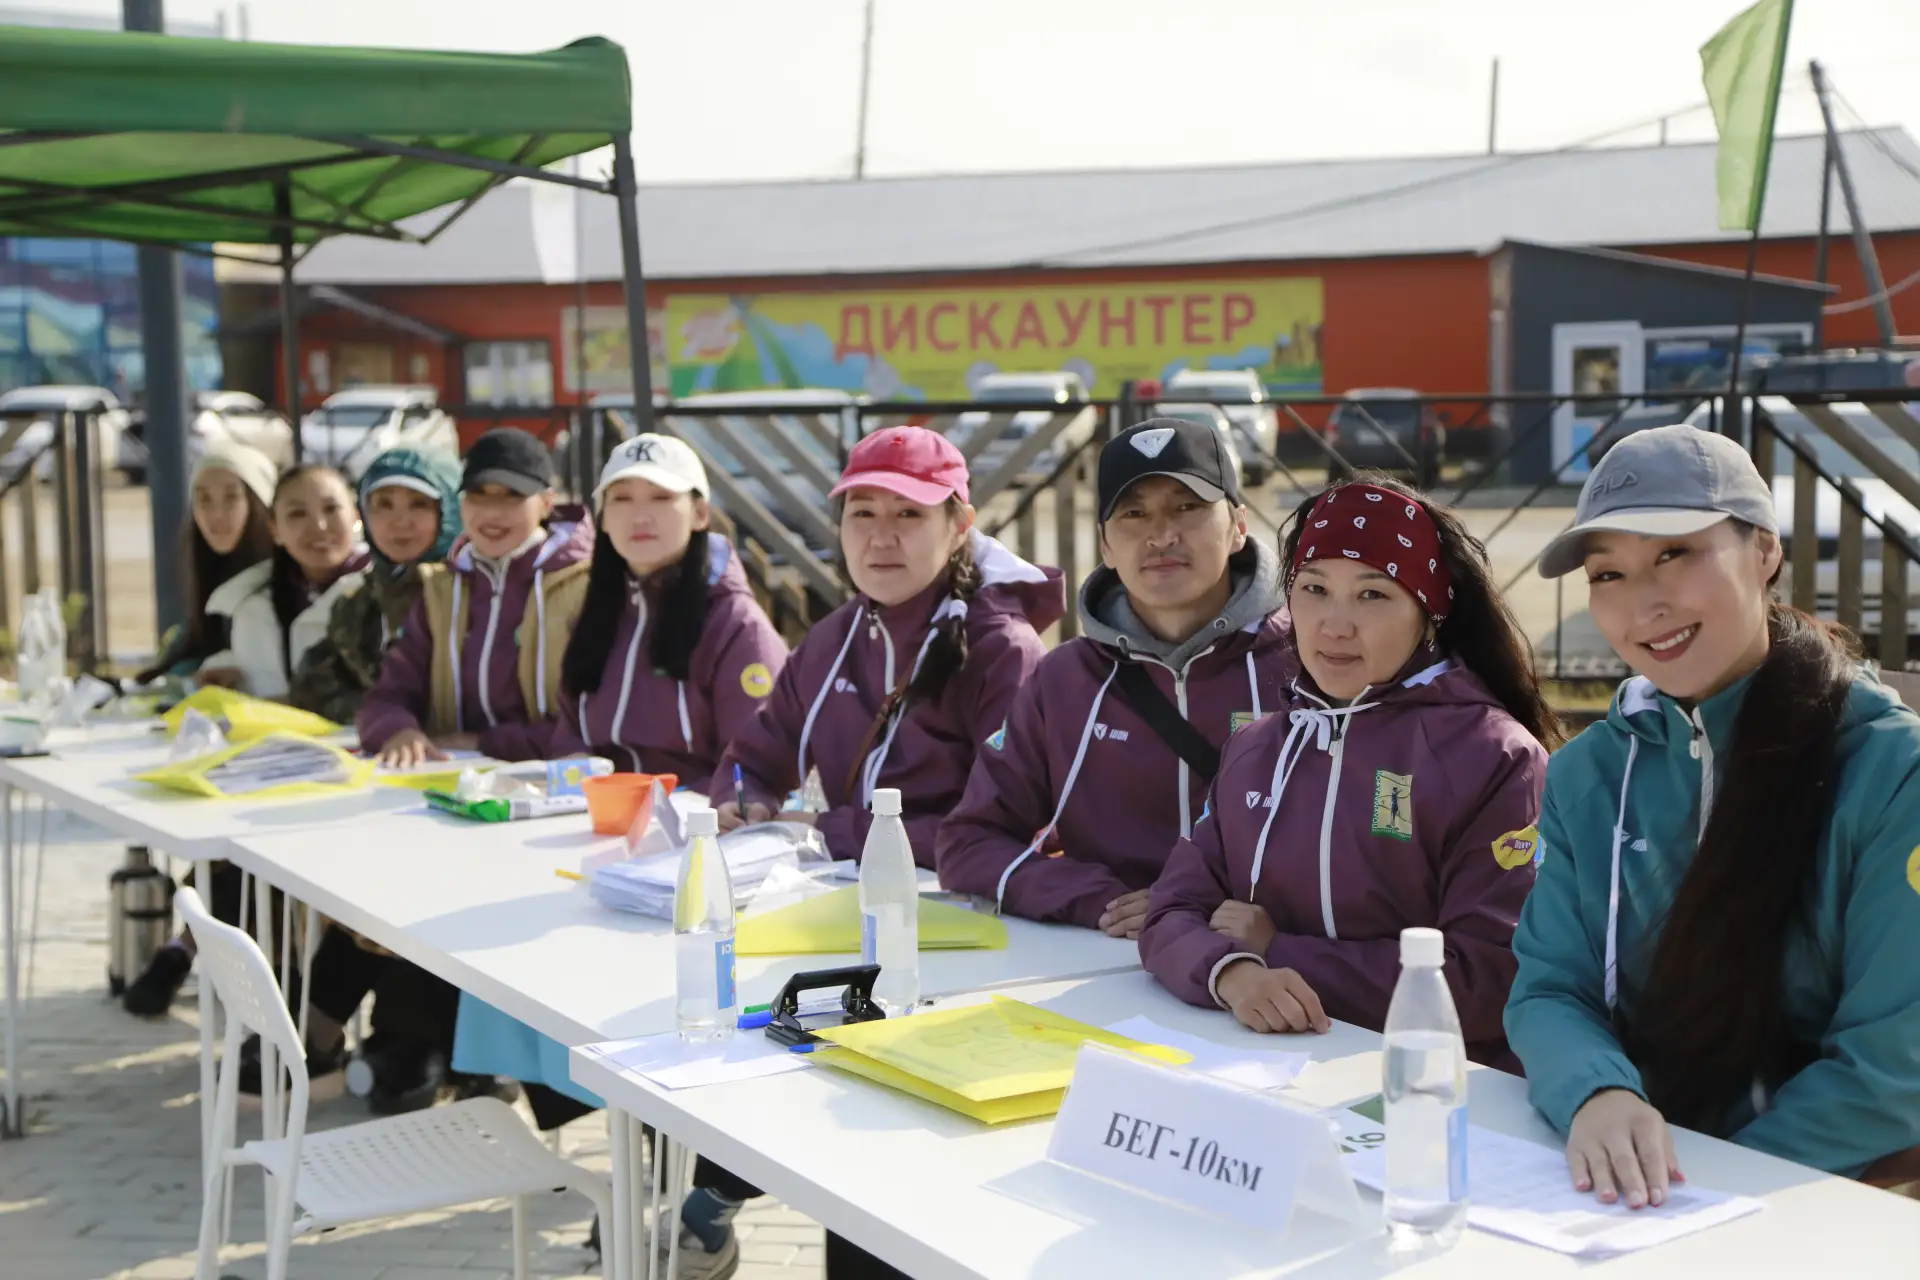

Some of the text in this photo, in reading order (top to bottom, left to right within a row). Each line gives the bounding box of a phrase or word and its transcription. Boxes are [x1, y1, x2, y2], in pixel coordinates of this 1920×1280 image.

[834, 293, 1257, 364] ДИСКАУНТЕР
[1589, 471, 1639, 502] FILA
[1102, 1110, 1263, 1192] БЕГ-10км
